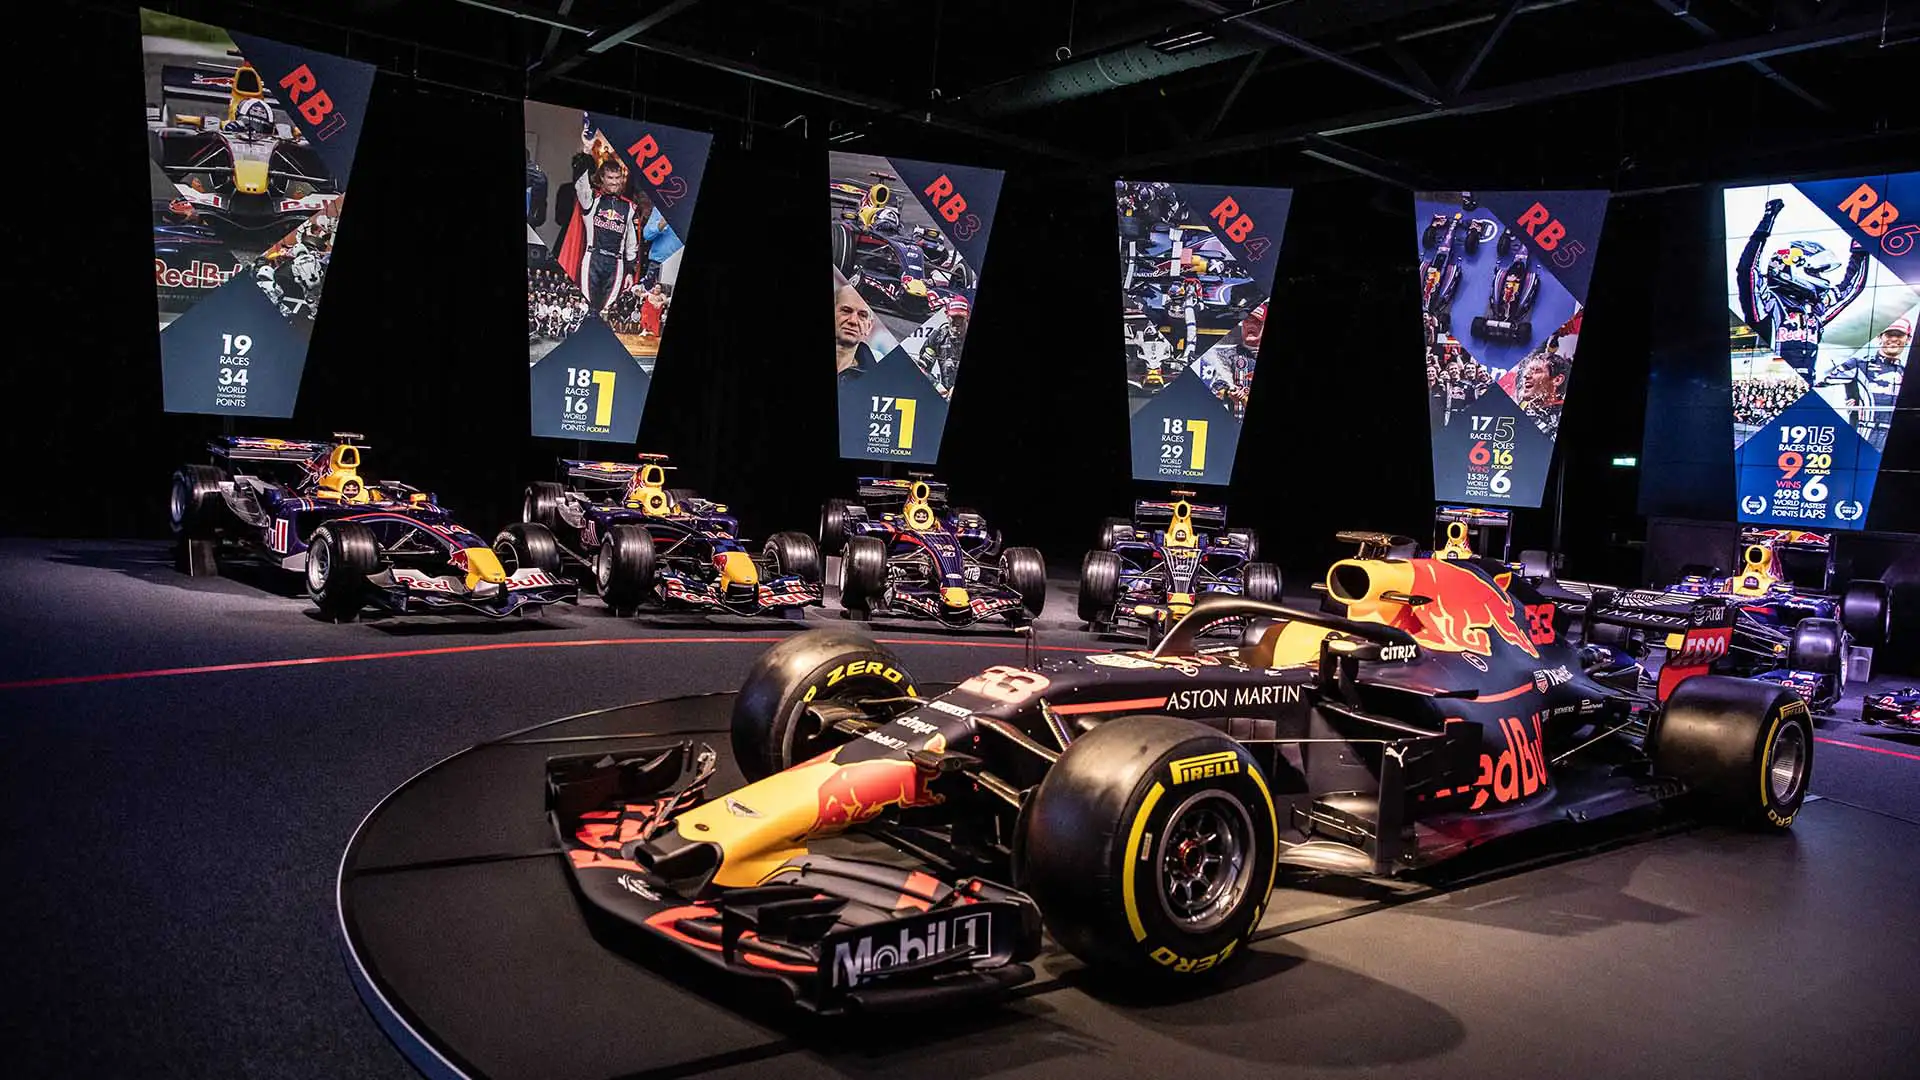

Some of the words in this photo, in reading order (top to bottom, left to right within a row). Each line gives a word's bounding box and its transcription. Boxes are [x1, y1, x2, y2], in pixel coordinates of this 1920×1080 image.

[279, 64, 348, 141] RB1
[627, 133, 688, 207] RB2
[923, 174, 982, 242] RB3
[1838, 183, 1920, 256] RB6
[1208, 195, 1272, 263] RB4
[1516, 201, 1586, 269] RB5
[222, 333, 252, 356] 19
[220, 355, 250, 366] RACES
[218, 367, 249, 386] 34
[567, 367, 591, 388] 18
[217, 385, 247, 394] WORLD
[565, 386, 590, 397] RACES
[592, 369, 617, 427] 1
[215, 397, 246, 407] POINTS
[564, 396, 588, 414] 16
[871, 395, 895, 413] 17
[562, 413, 587, 421] WORLD
[870, 412, 893, 422] RACES
[895, 397, 917, 449] 1
[1163, 417, 1183, 434] 18
[1471, 415, 1494, 431] 17
[561, 423, 587, 432] POINTS
[586, 426, 610, 434] PODIUM
[869, 422, 891, 438] 24
[1470, 432, 1493, 441] RACES
[1493, 416, 1516, 443] 5
[1780, 426, 1807, 444] 19
[1807, 426, 1835, 445] 15
[1161, 434, 1185, 443] RACES
[1186, 419, 1209, 470] 1
[1493, 442, 1515, 450] POLES
[866, 446, 889, 454] POINTS
[1160, 444, 1183, 459] 29
[1469, 440, 1491, 465] 6
[1493, 448, 1514, 466] 16
[1778, 444, 1806, 452] RACES
[1806, 444, 1833, 453] POLES
[1778, 451, 1804, 480] 9
[1805, 453, 1832, 469] 20
[1159, 467, 1182, 476] POINTS
[1466, 480, 1489, 488] WORLD
[1490, 469, 1512, 494] 6
[1776, 480, 1802, 489] WINS
[1802, 475, 1829, 502] 6
[1465, 489, 1489, 497] POINTS
[1773, 489, 1800, 500] 498
[1772, 510, 1799, 518] POINTS
[1799, 509, 1826, 519] LAPS
[396, 575, 454, 593] Red
[504, 572, 550, 590] Bull
[1705, 606, 1726, 621] AT&T
[826, 660, 905, 687] ZERO
[1166, 690, 1228, 711] ASTON
[1233, 685, 1301, 707] MARTIN
[1169, 750, 1240, 785] PIRELLI
[1471, 717, 1520, 811] ed
[834, 920, 948, 988] Mobil
[1149, 938, 1239, 975] ZERO
